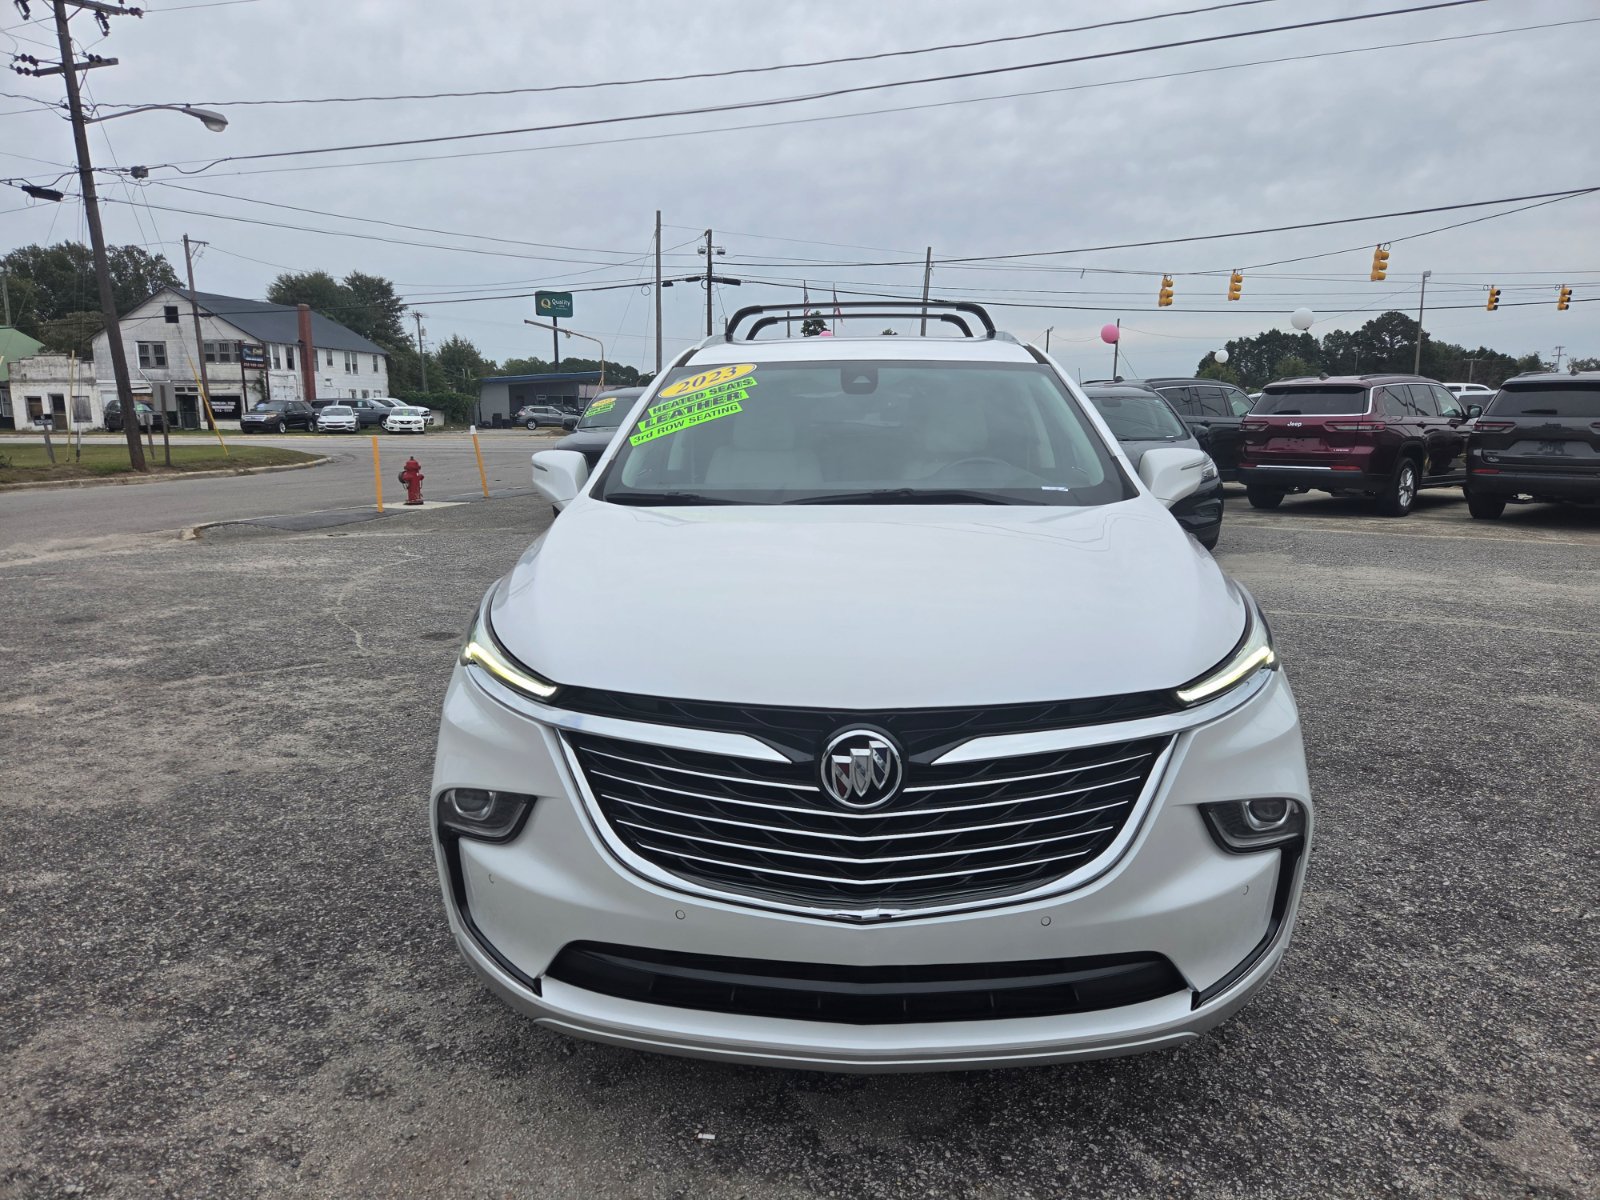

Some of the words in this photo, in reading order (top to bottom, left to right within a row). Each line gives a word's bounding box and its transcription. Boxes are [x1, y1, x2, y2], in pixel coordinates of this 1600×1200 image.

[552, 298, 570, 307] Quality
[652, 391, 707, 414] HEATED
[709, 378, 754, 396] SEATS
[677, 366, 738, 393] 2023
[633, 430, 654, 444] 3rd
[657, 420, 685, 435] ROW
[688, 404, 739, 424] SEATING
[644, 391, 742, 428] LEATHER
